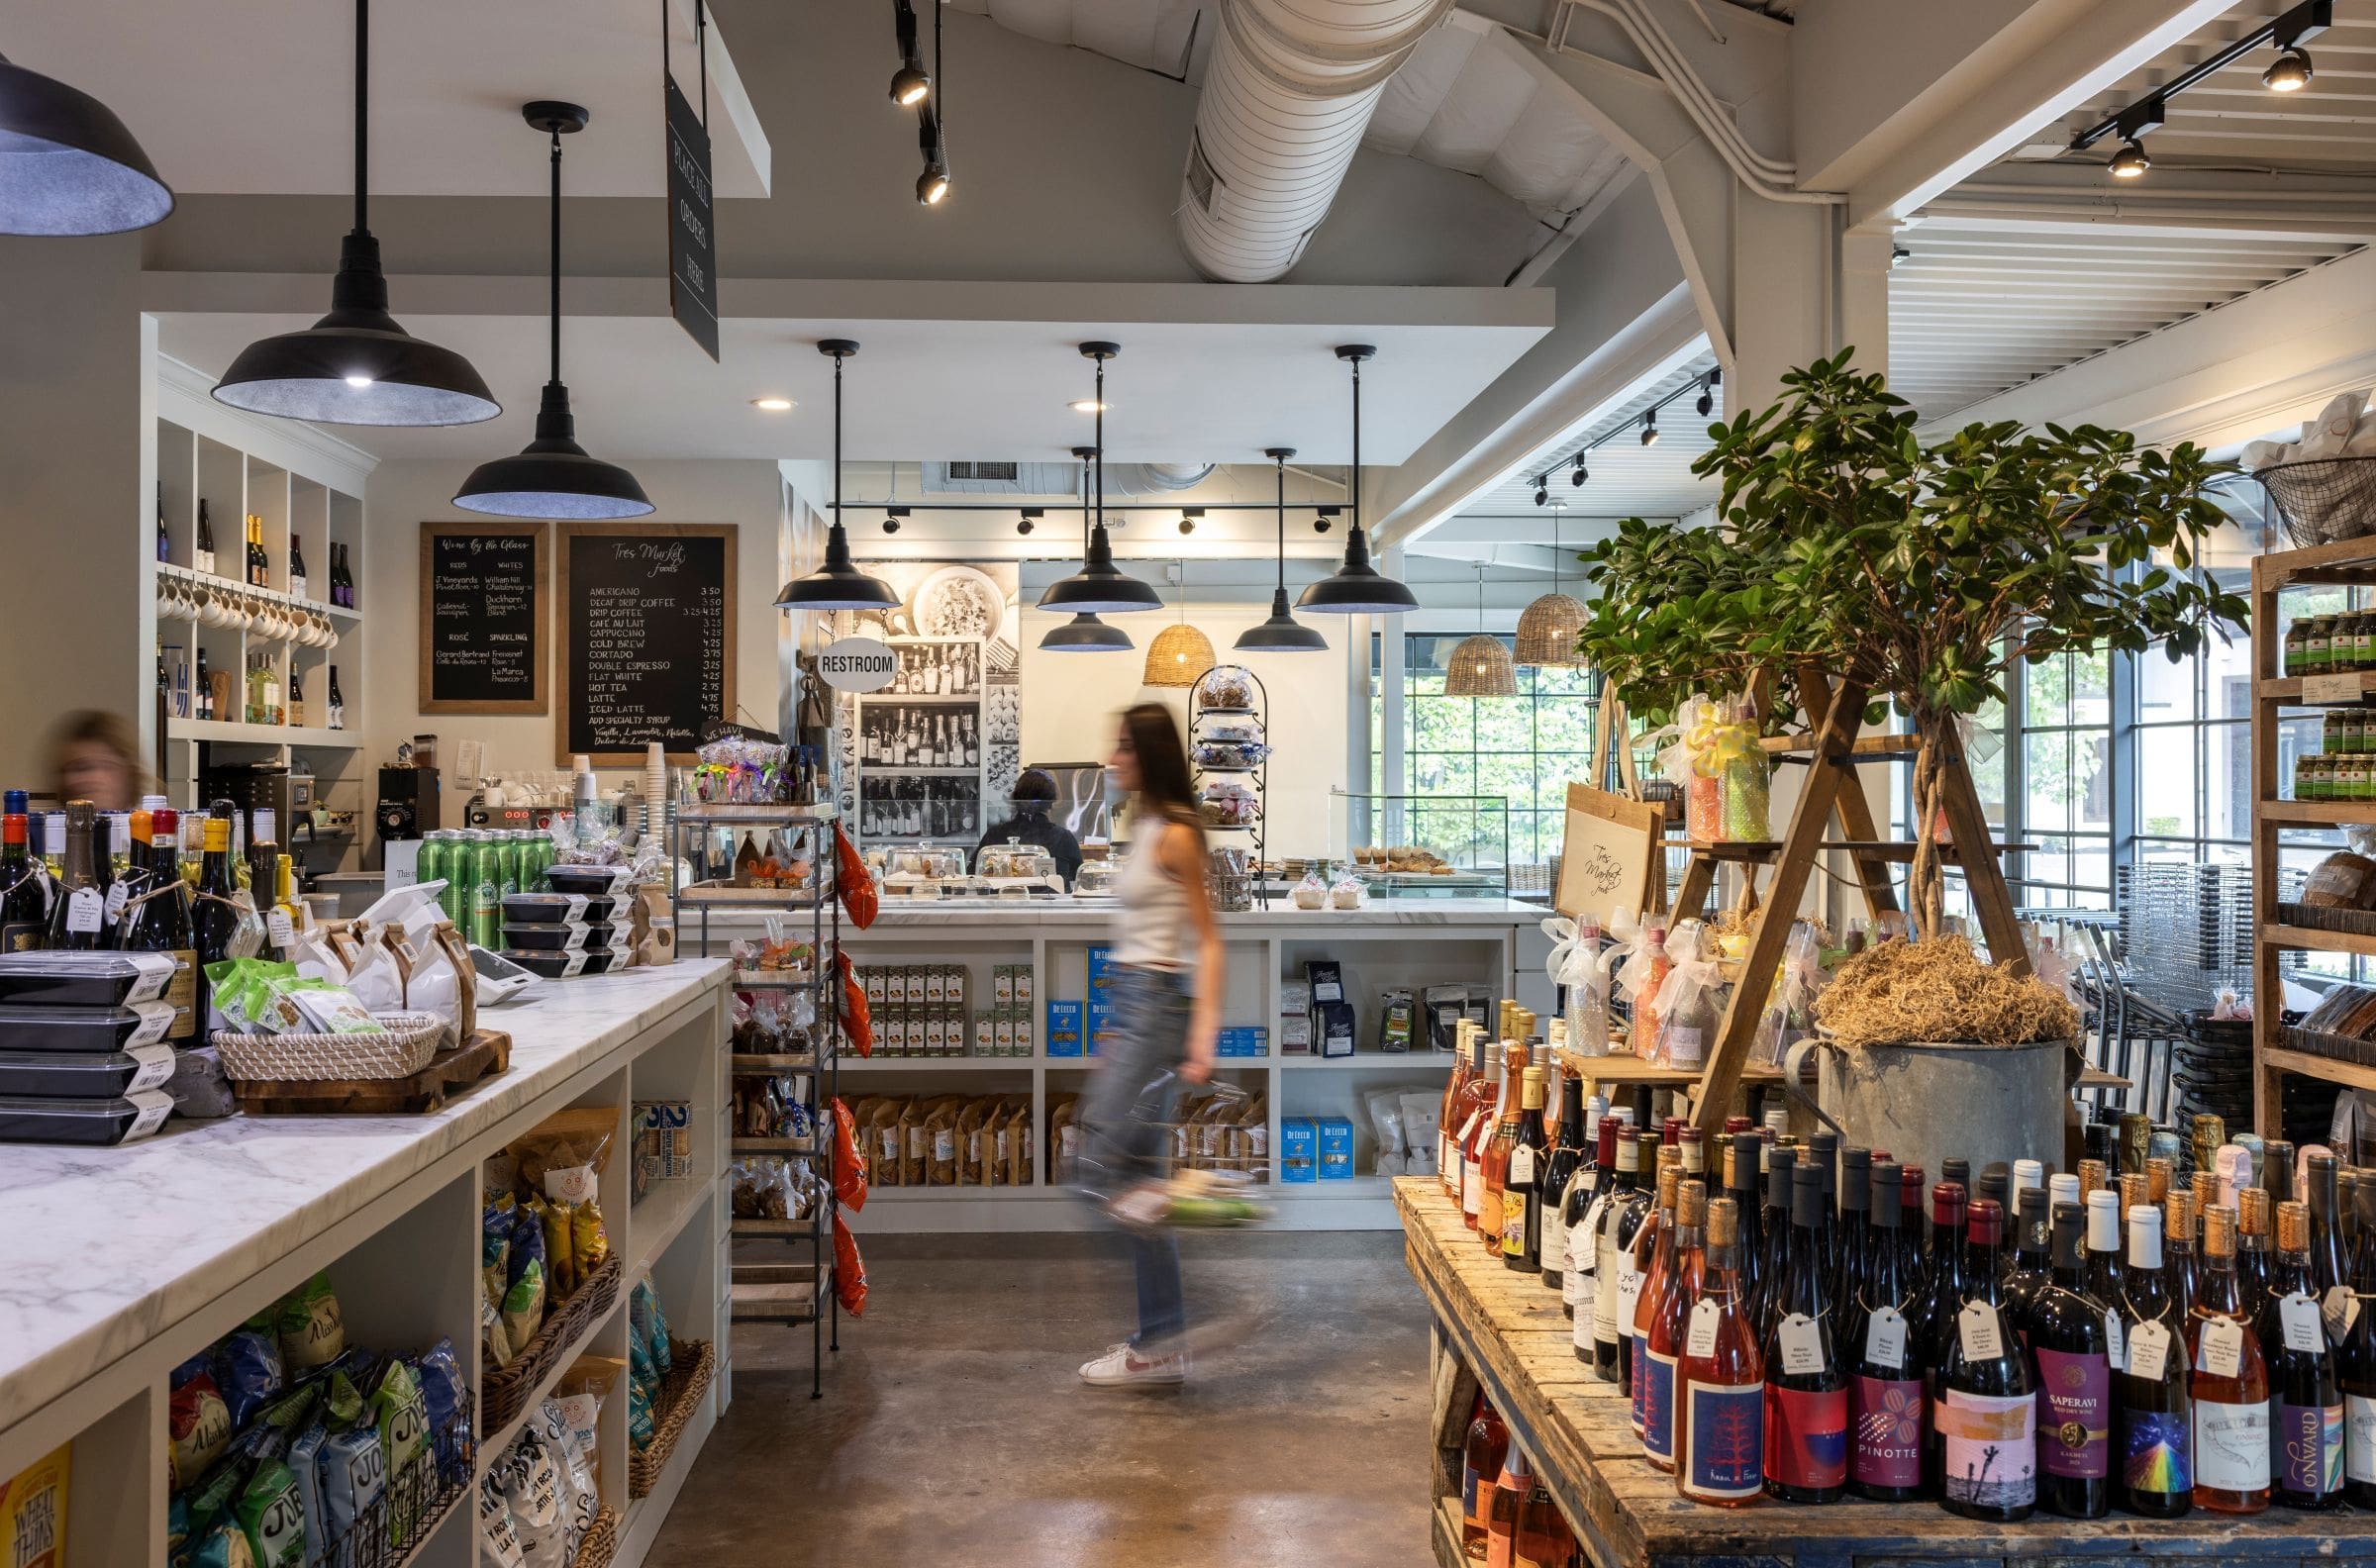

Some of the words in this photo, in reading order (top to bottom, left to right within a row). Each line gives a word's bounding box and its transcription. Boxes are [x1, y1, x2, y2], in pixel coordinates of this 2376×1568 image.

[674, 140, 695, 189] PLACE
[696, 175, 709, 209] ALL
[680, 198, 706, 249] ORDERS
[687, 253, 704, 293] HERE
[442, 539, 466, 550] Wine
[470, 538, 482, 555] by
[485, 539, 498, 550] the
[501, 539, 530, 551] Glass
[612, 542, 636, 560] Tres
[639, 541, 685, 563] Market
[589, 587, 640, 596] AMERICANO
[590, 598, 615, 607] DECAF
[619, 598, 637, 607] DRIP
[641, 598, 676, 607] COFFEE
[589, 608, 608, 617] DRIP
[610, 608, 643, 617] COFFEE
[589, 618, 611, 628] CAFÉ
[613, 619, 625, 628] AU
[626, 619, 645, 628] LAIT
[448, 632, 469, 641] ROSÉ
[489, 633, 528, 641] SPARKLING
[589, 629, 645, 637] CAPPUCCINO
[590, 639, 613, 648] COLD
[617, 639, 645, 648] BREW
[589, 650, 634, 659] CORTADO
[588, 661, 622, 670] DOUBLE
[626, 660, 671, 670] ESPRESSO
[823, 655, 893, 672] RESTROOM
[615, 672, 643, 681] WHITE
[588, 683, 606, 692] HOT
[610, 683, 628, 692] TEA
[588, 694, 616, 703] LATTE
[589, 705, 613, 714] ICED
[605, 716, 644, 725] SPECIALTY
[645, 716, 671, 725] SYRUP
[704, 733, 717, 741] WE
[1593, 844, 1612, 864] Tres
[397, 870, 411, 879] This
[1585, 860, 1622, 889] Market
[2049, 1394, 2097, 1408] SAPERAVI
[1858, 1444, 1918, 1458] PINOTTE
[2293, 1412, 2320, 1488] ONWARD
[14, 1485, 57, 1537] WHEAT
[14, 1512, 55, 1568] THINS
